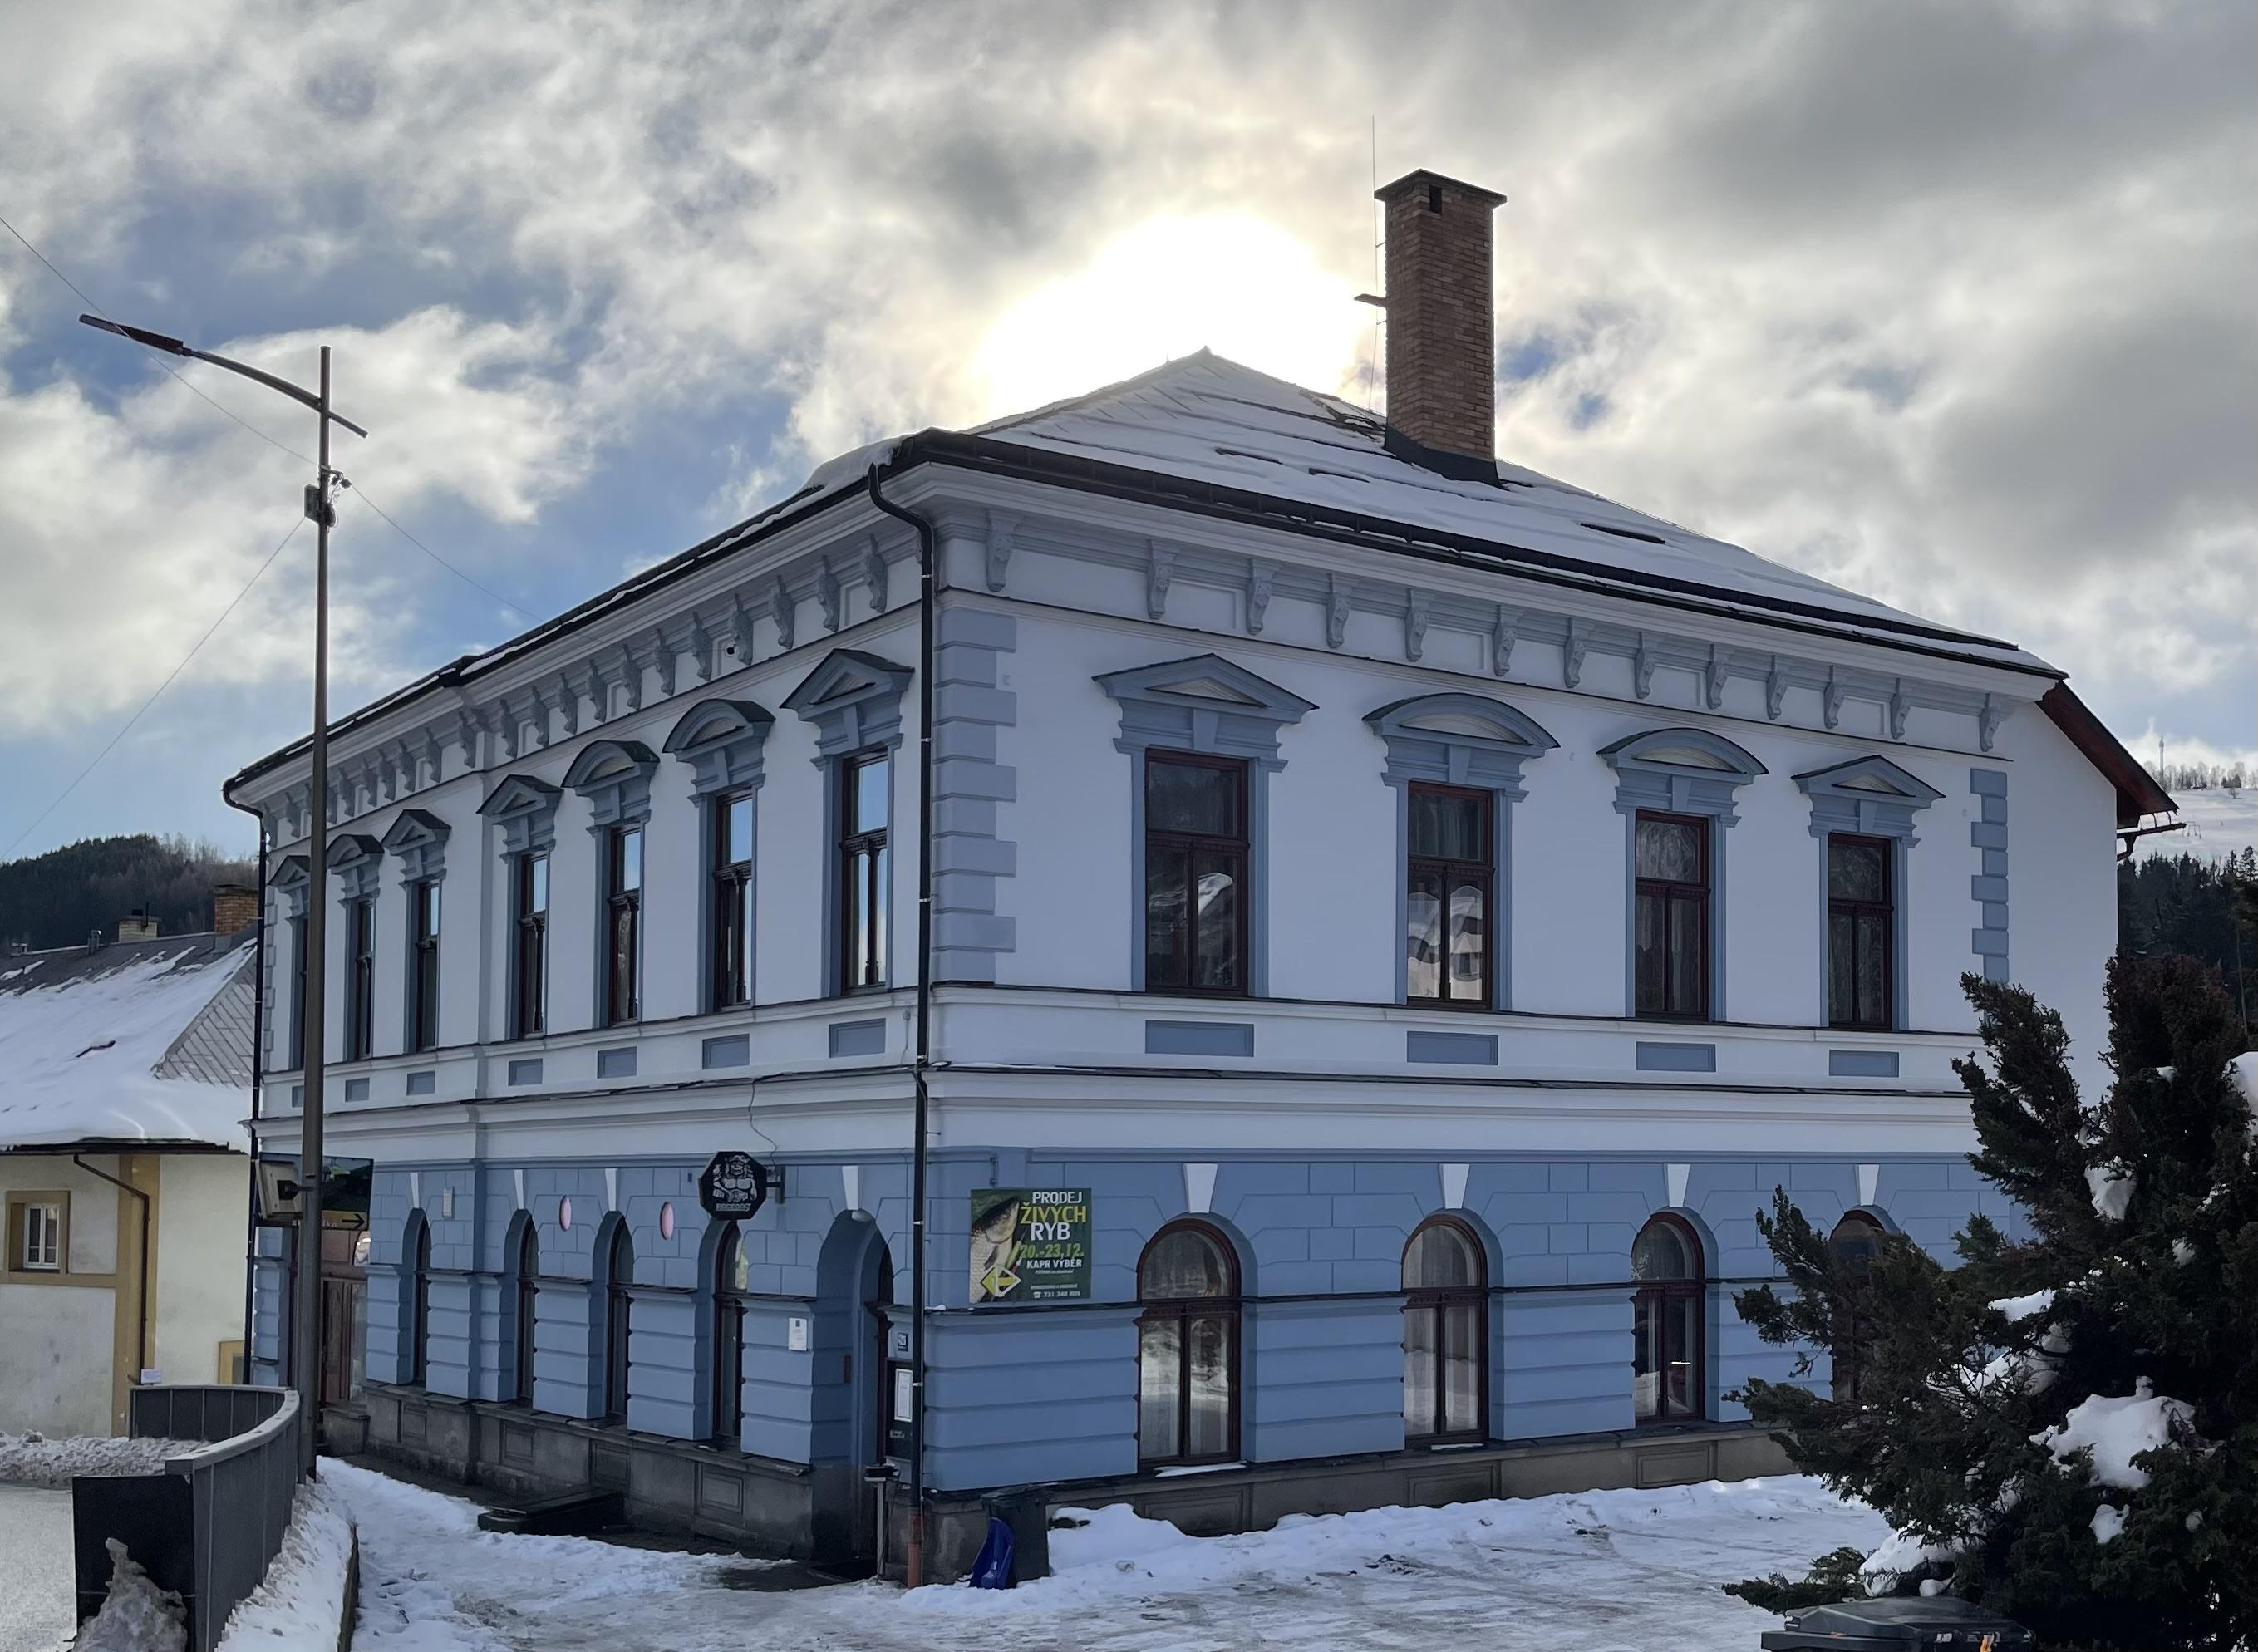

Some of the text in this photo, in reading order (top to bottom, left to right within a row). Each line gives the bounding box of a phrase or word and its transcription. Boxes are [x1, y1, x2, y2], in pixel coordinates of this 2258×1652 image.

[1032, 1191, 1082, 1204] PRODEJ
[1020, 1202, 1086, 1224] ŽIVÝCH
[1031, 1222, 1070, 1241] RYB
[1026, 1259, 1050, 1269] KAPR
